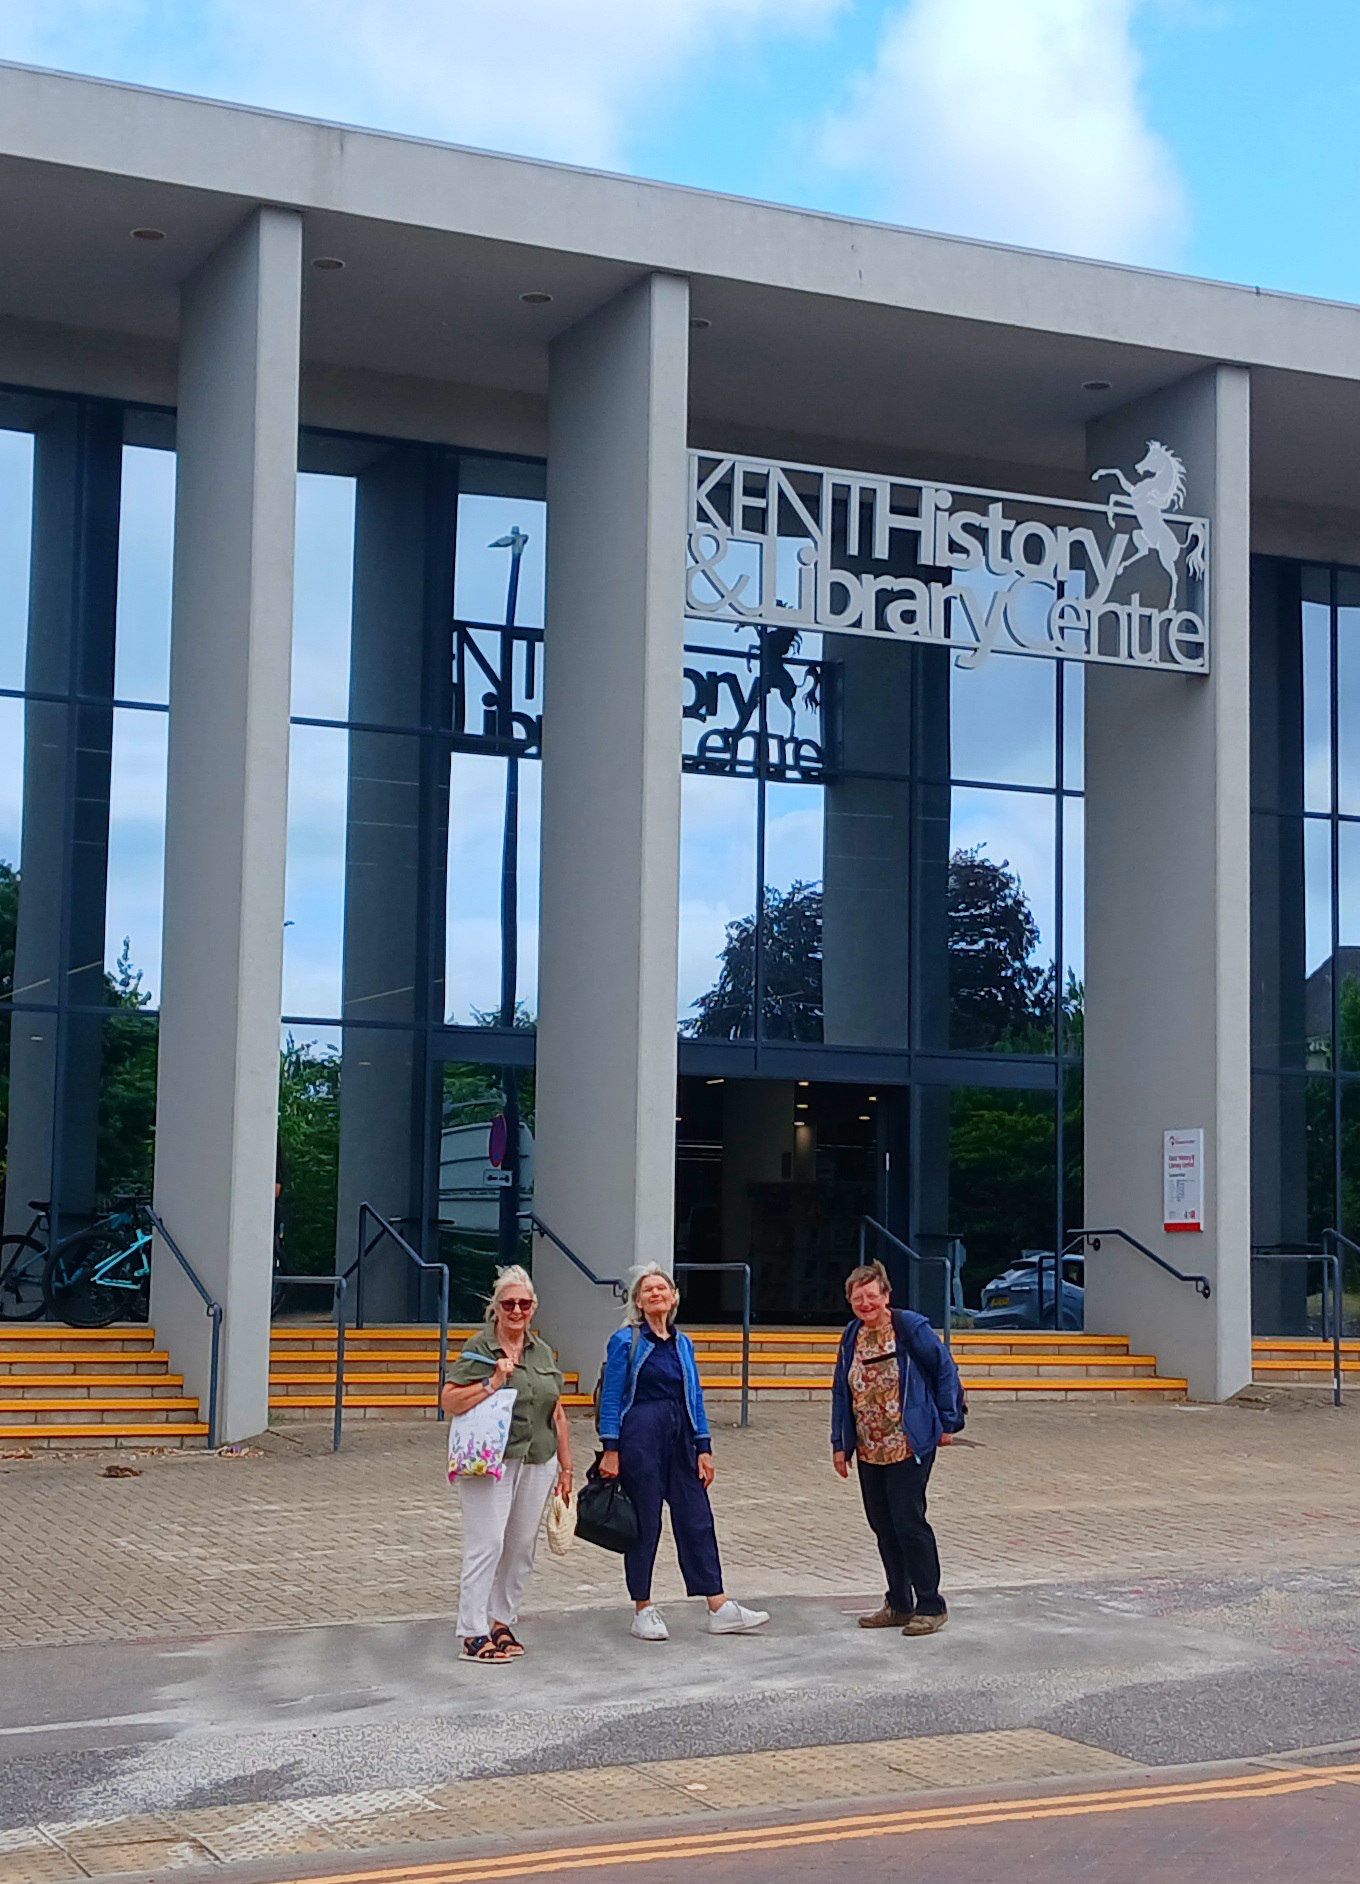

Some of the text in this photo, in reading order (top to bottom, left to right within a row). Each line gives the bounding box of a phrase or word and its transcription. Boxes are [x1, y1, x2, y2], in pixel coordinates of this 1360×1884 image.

[686, 527, 1206, 669] & Library Centre
[688, 455, 1130, 606] KENT History
